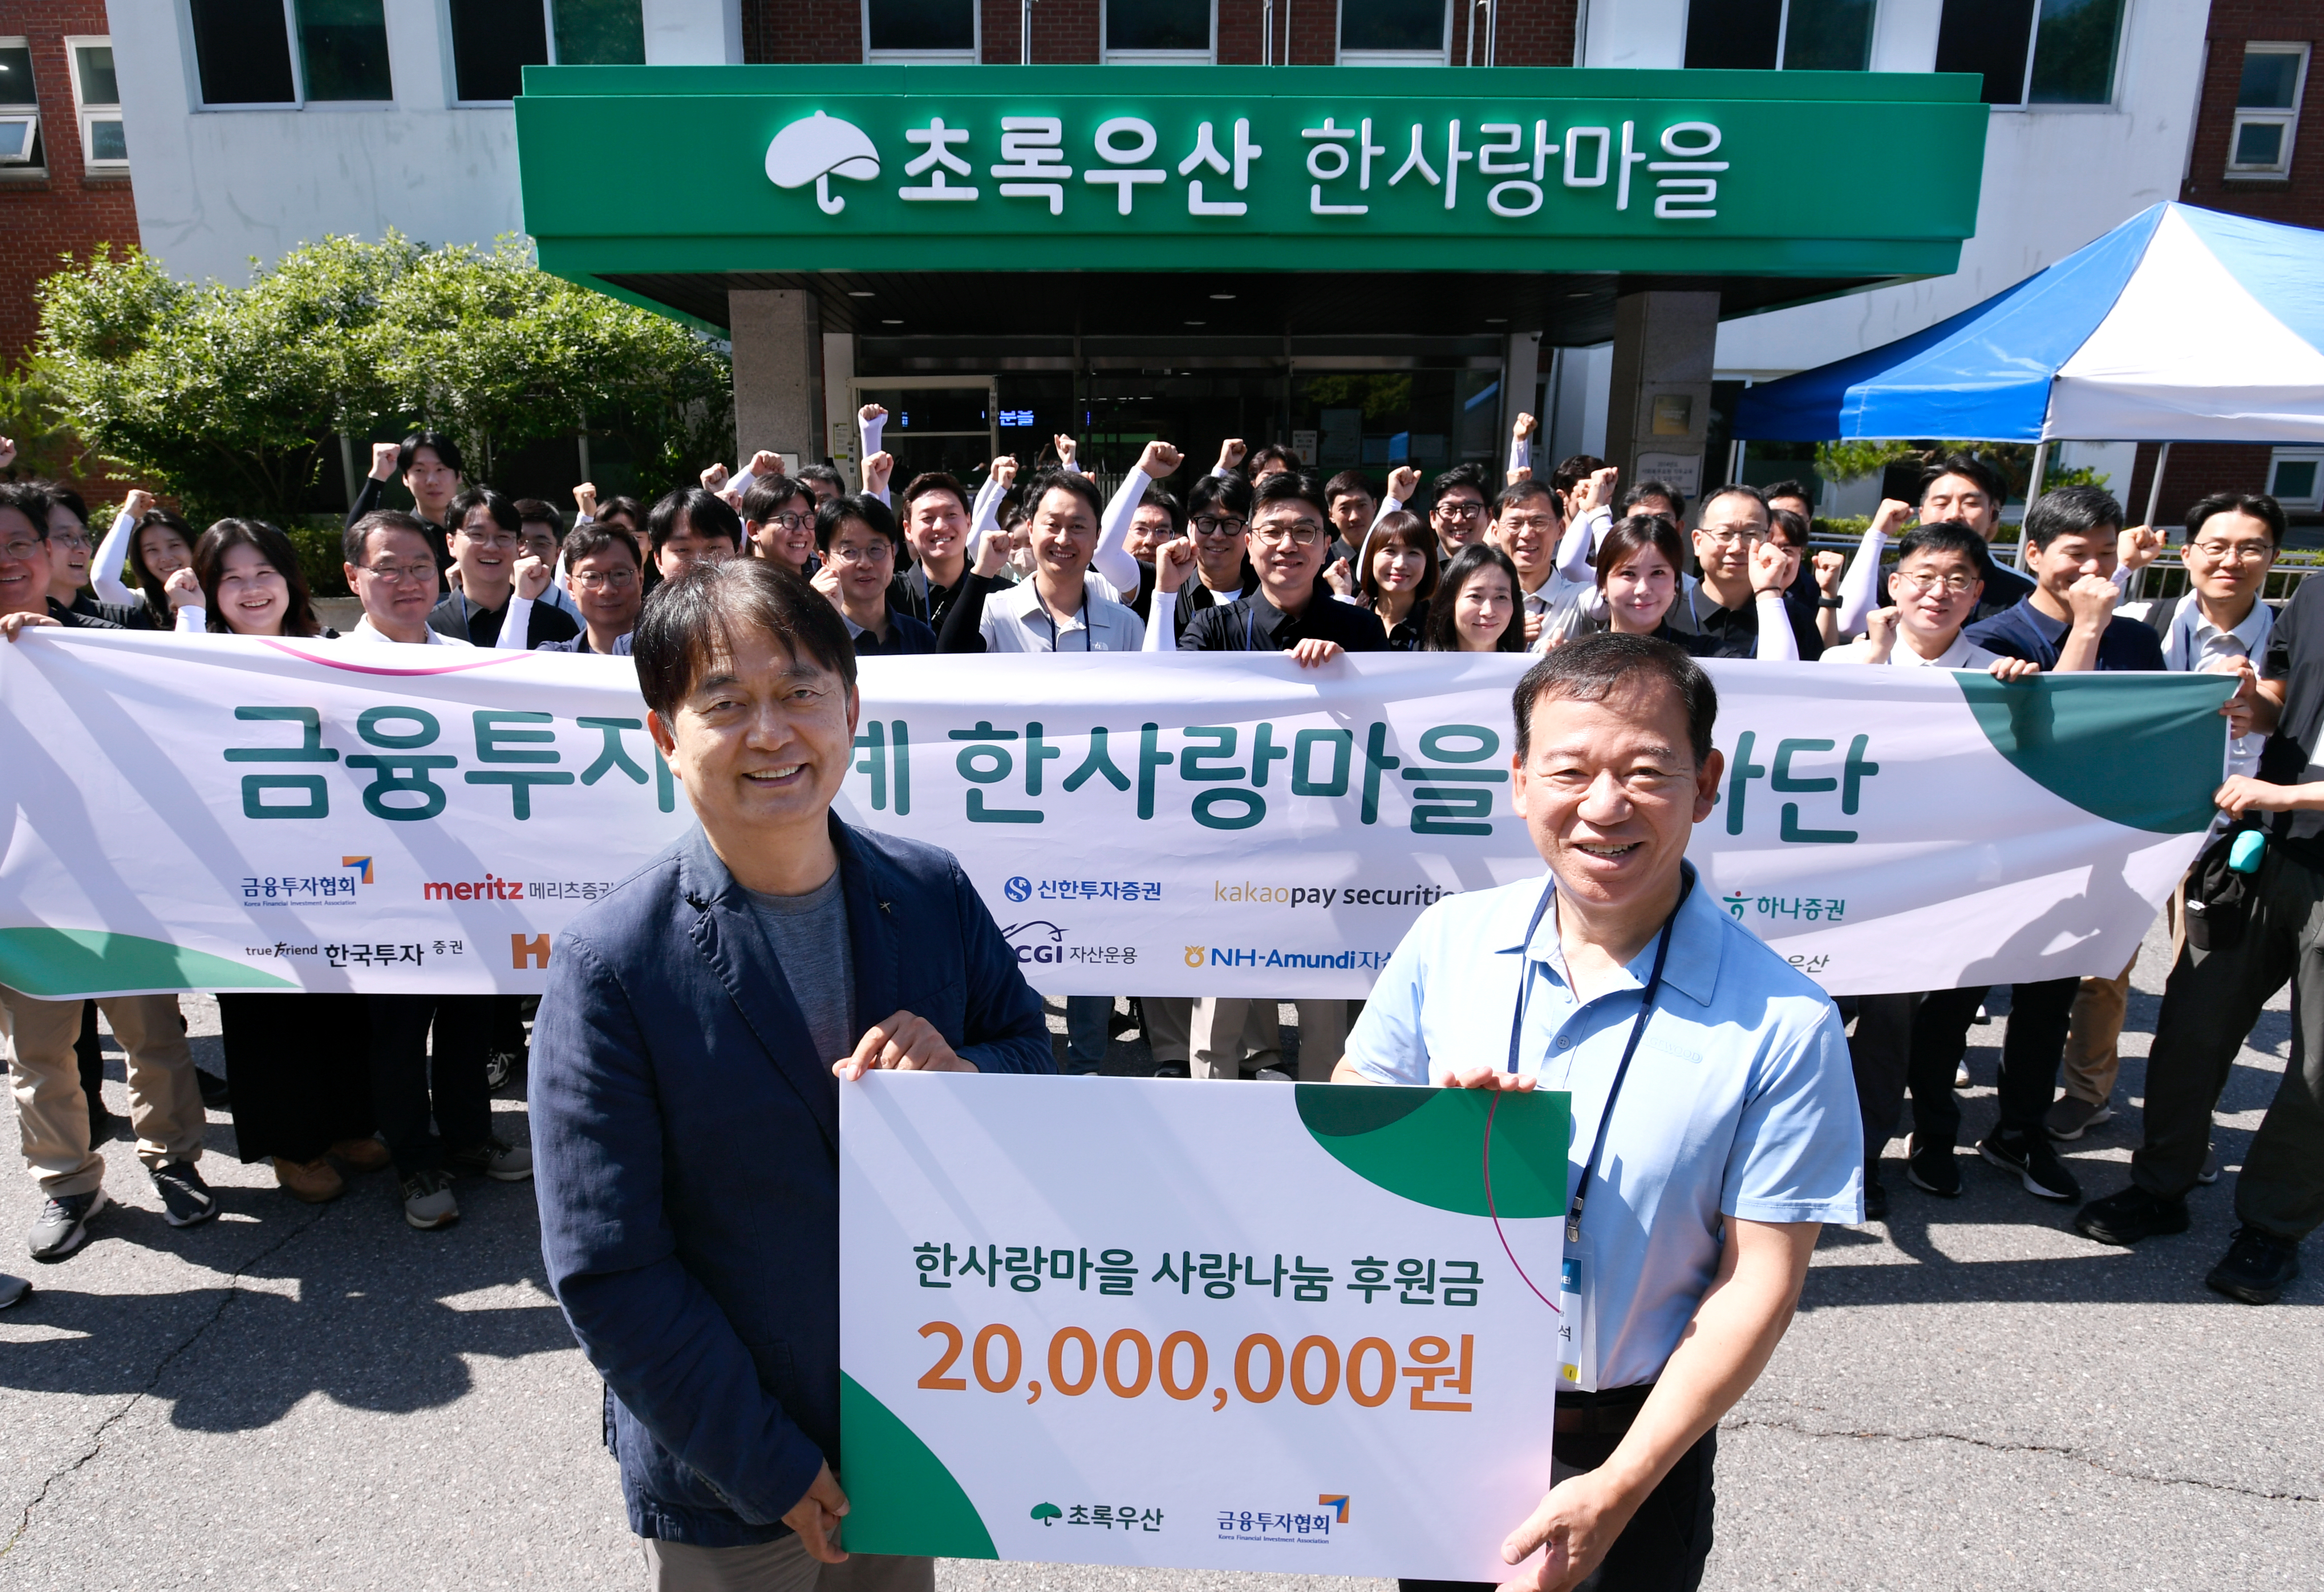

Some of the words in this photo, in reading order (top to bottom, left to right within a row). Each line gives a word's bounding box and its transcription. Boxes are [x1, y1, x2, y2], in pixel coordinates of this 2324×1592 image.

[898, 116, 1262, 217] 초록우산
[1301, 117, 1729, 219] 한사랑마을
[948, 720, 1510, 837] 한사랑마을
[241, 876, 356, 898] 금융투자협회
[424, 873, 524, 901] meritz
[1038, 879, 1161, 901] 신한투자증권
[1214, 880, 1338, 909] kakaopay
[1343, 884, 1455, 907] securiti
[1758, 897, 1845, 921] 하나증권
[324, 943, 425, 968] 한국투자
[432, 940, 463, 955] 증권
[1014, 945, 1063, 963] CGI
[1070, 946, 1138, 964] 자산운용
[1787, 954, 1830, 973] 우산
[913, 1241, 1139, 1296] 한사랑마을
[1151, 1250, 1334, 1302] 사랑나눔
[1346, 1255, 1484, 1306] 후원금
[918, 1321, 1474, 1413] 20,000,000원
[1066, 1504, 1165, 1532] 초록우산
[1217, 1510, 1330, 1535] 금융투자협회
